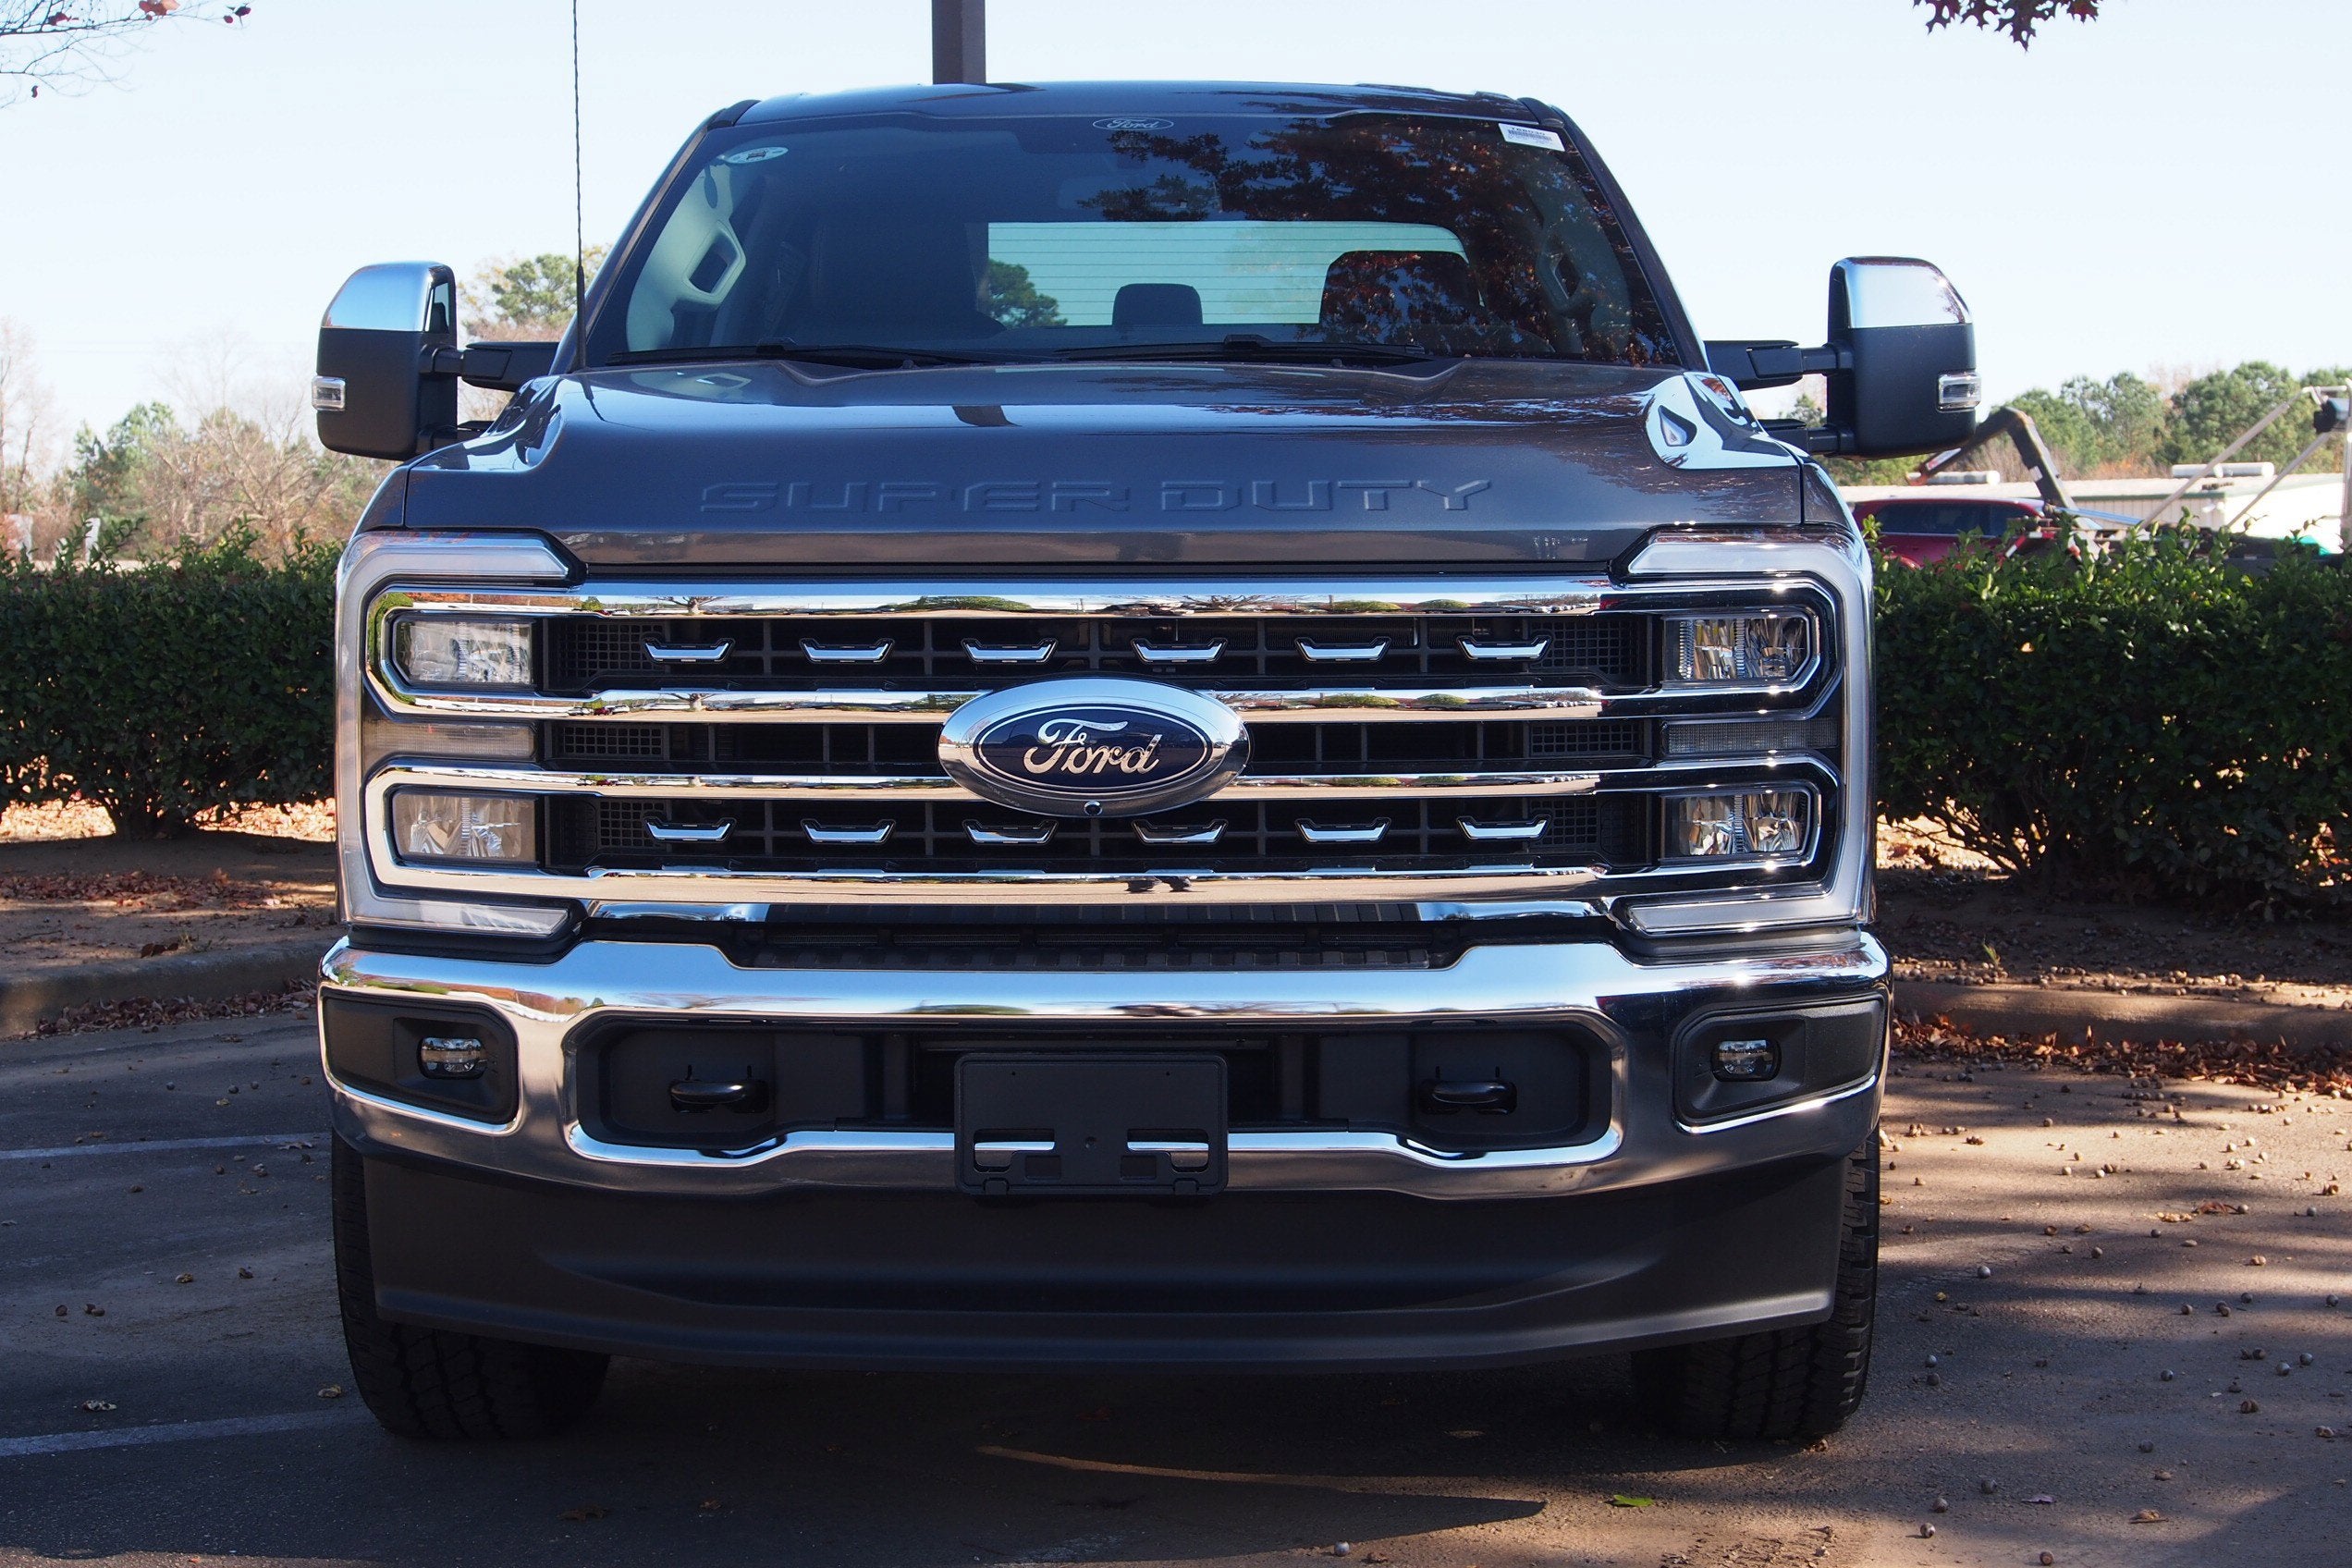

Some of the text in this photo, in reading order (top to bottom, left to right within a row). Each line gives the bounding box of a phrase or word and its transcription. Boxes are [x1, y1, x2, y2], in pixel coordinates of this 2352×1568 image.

[1107, 118, 1159, 129] Ford
[700, 479, 1492, 513] SUPER DUTY
[1023, 717, 1163, 774] Ford
